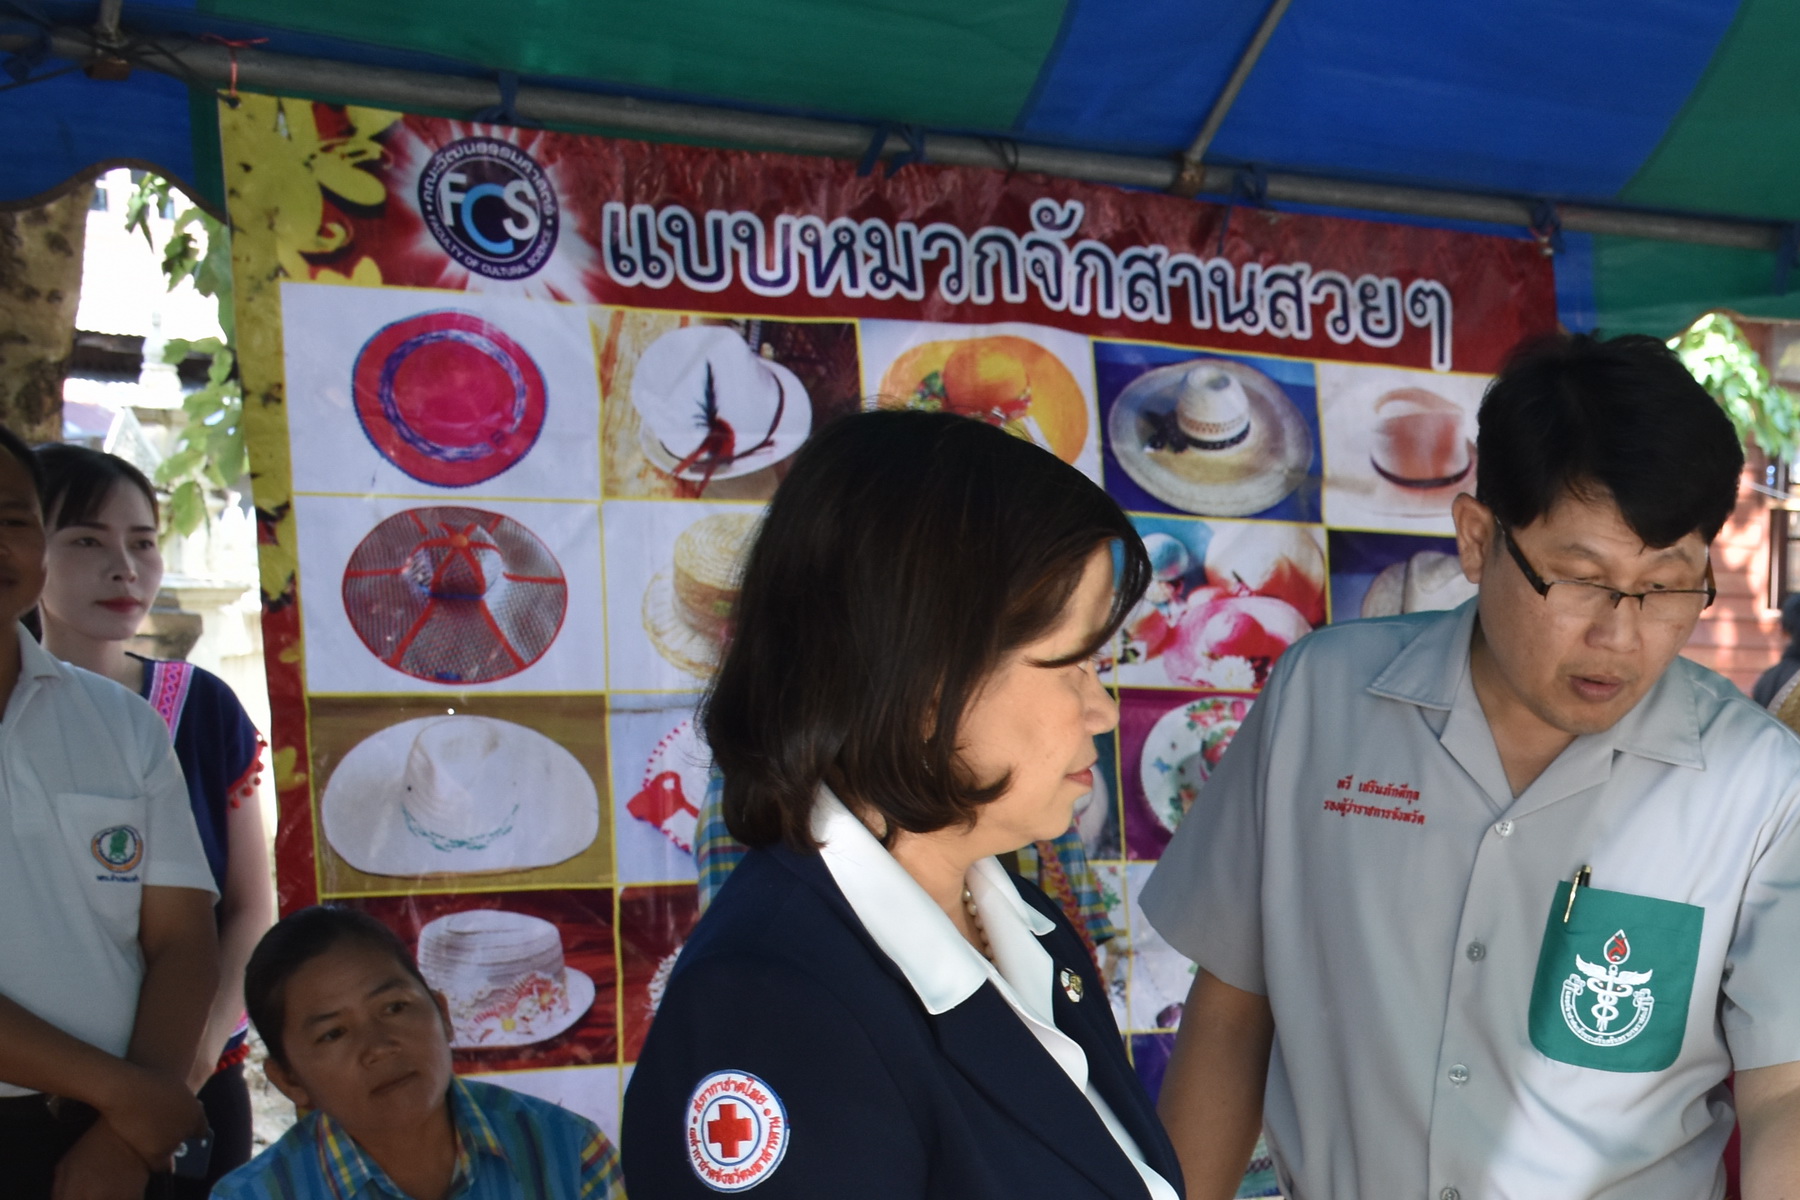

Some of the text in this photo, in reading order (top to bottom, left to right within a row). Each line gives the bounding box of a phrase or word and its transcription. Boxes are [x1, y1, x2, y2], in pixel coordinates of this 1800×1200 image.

[429, 215, 463, 259] FACULTY
[464, 255, 479, 268] OF
[439, 172, 540, 255] FCS
[602, 198, 1452, 372] แบบหมวกจักสานสวยๆ
